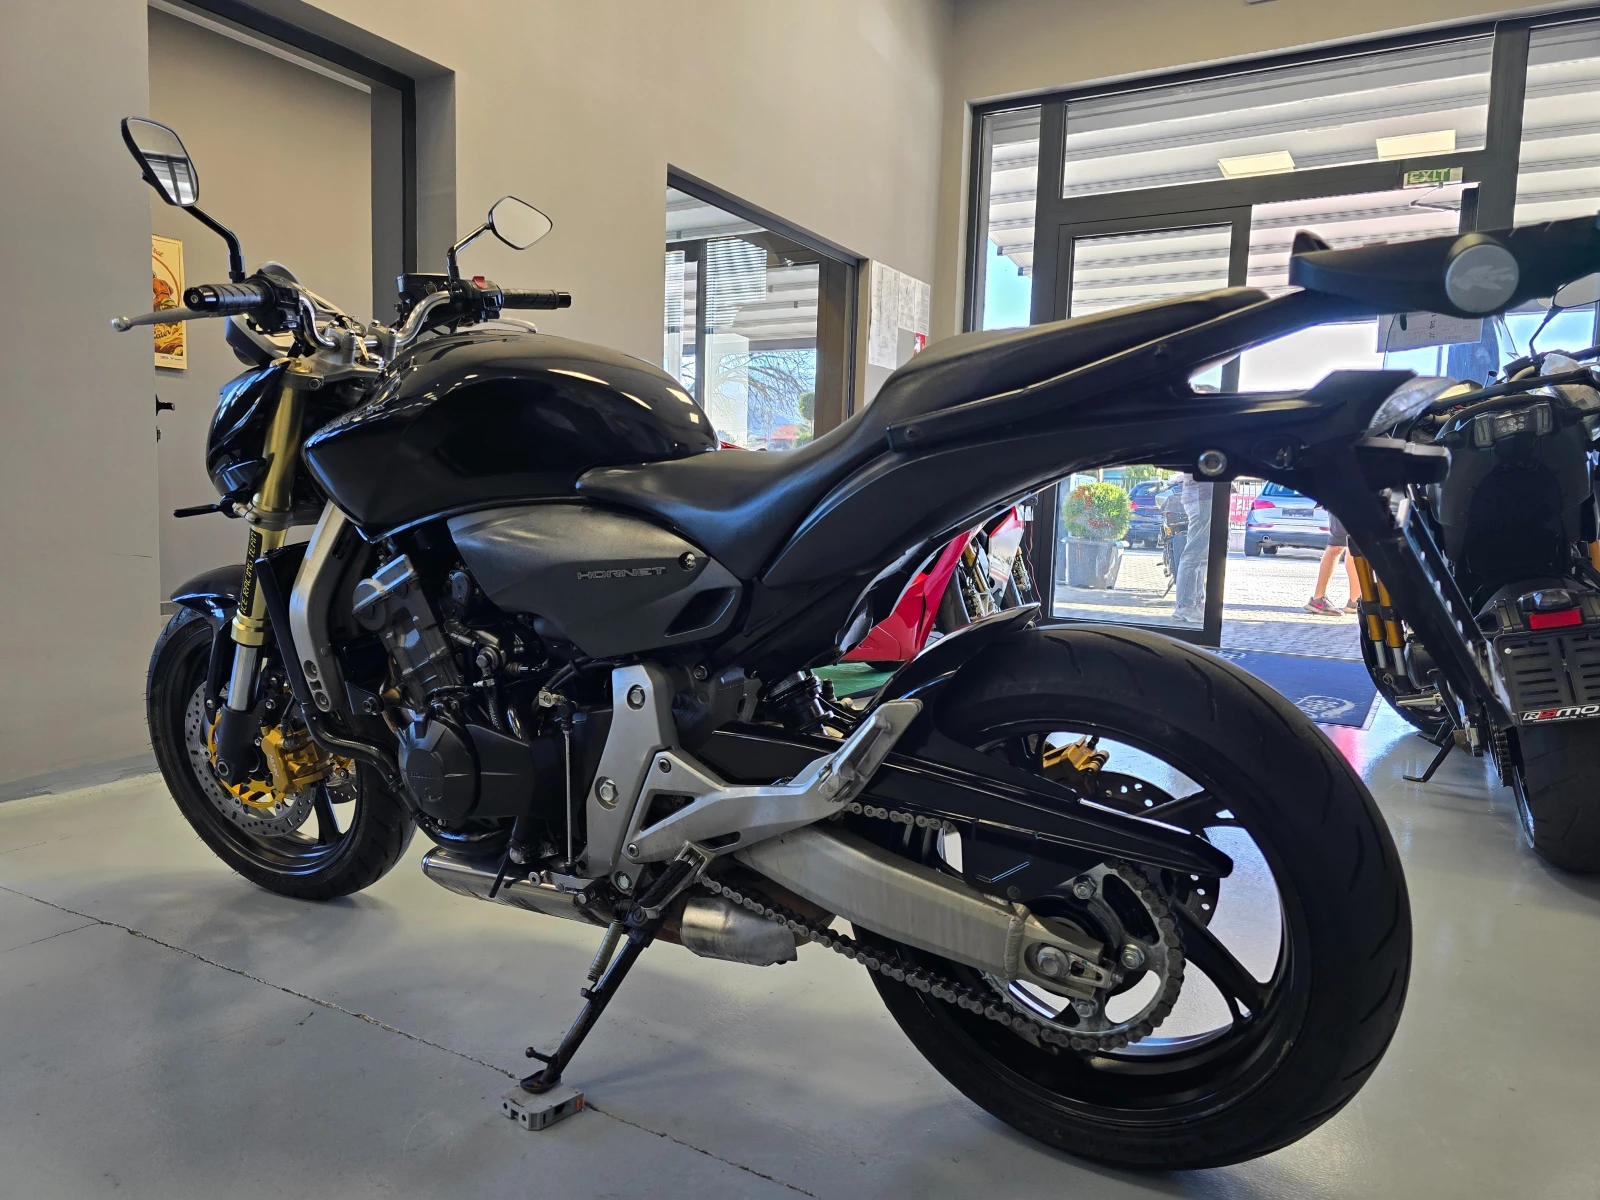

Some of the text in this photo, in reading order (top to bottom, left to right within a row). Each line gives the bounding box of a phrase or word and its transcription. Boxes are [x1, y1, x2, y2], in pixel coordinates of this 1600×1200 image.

[1410, 167, 1449, 184] EXIT
[244, 560, 253, 597] RACING
[577, 567, 666, 579] HORNET
